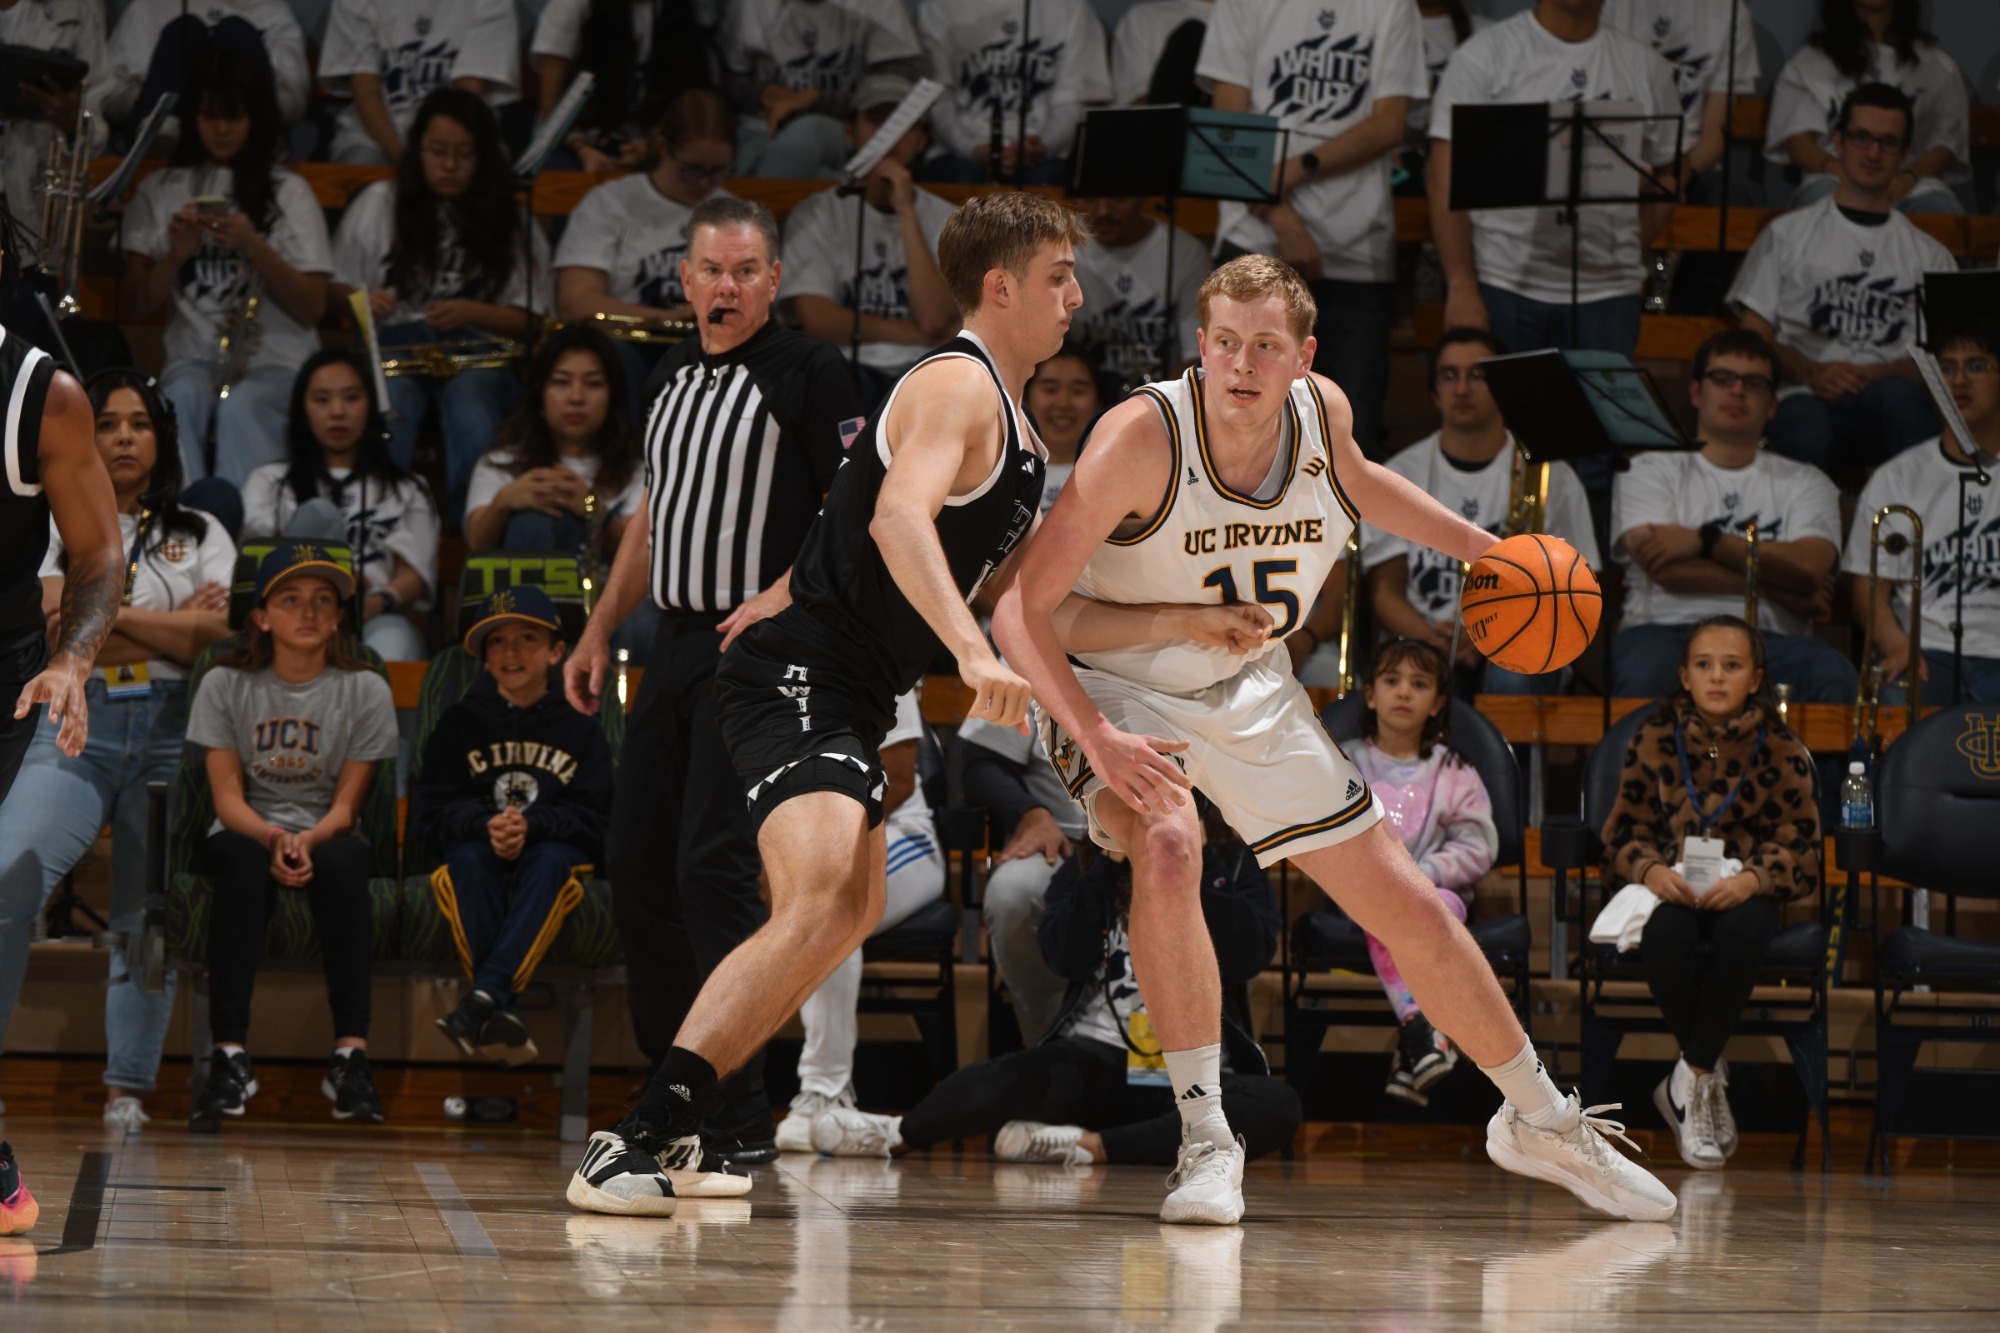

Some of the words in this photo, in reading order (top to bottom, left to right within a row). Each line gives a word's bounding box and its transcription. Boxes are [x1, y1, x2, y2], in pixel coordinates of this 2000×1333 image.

[1277, 49, 1369, 85] WHITE
[1294, 76, 1353, 105] OUT
[1820, 277, 1909, 319] WHITE
[1184, 528, 1217, 555] UC
[1223, 517, 1323, 550] IRVINE
[1201, 557, 1302, 642] 15
[255, 718, 320, 757] UCI
